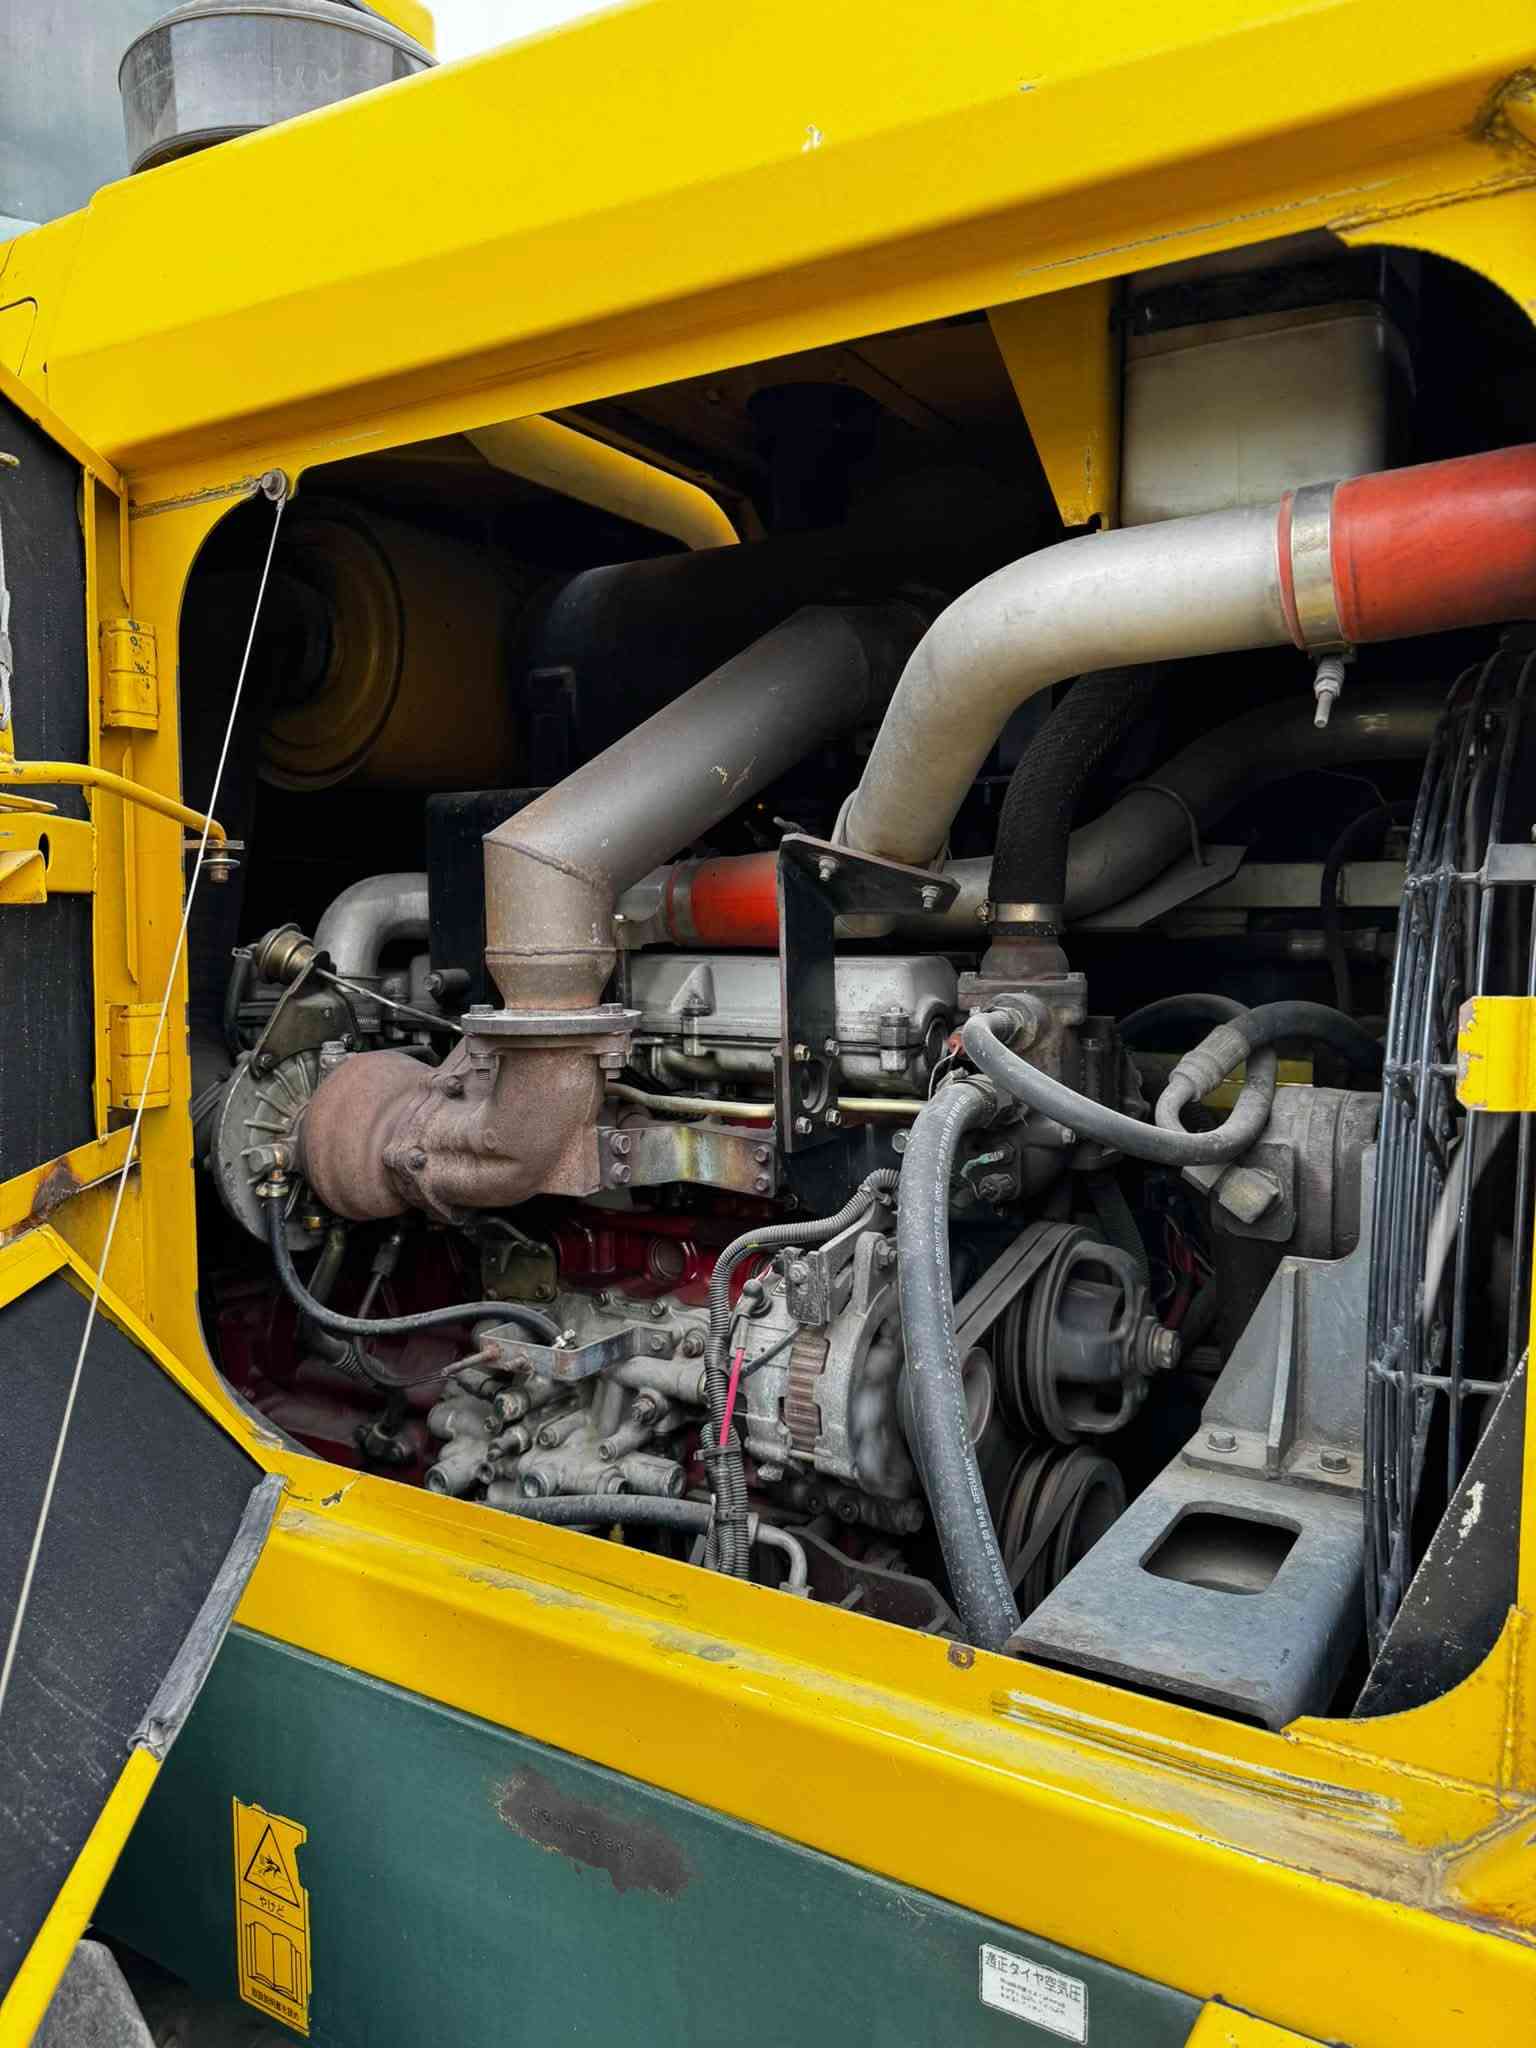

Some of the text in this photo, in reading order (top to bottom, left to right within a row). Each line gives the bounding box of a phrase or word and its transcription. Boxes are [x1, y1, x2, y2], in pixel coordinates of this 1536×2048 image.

[963, 1456, 982, 1505] GERMANY
[975, 1508, 988, 1528] BAR
[991, 1563, 1002, 1585] BAR
[259, 1895, 285, 1918] やけど
[985, 1951, 1081, 2003] 適正タイヤ空気圧
